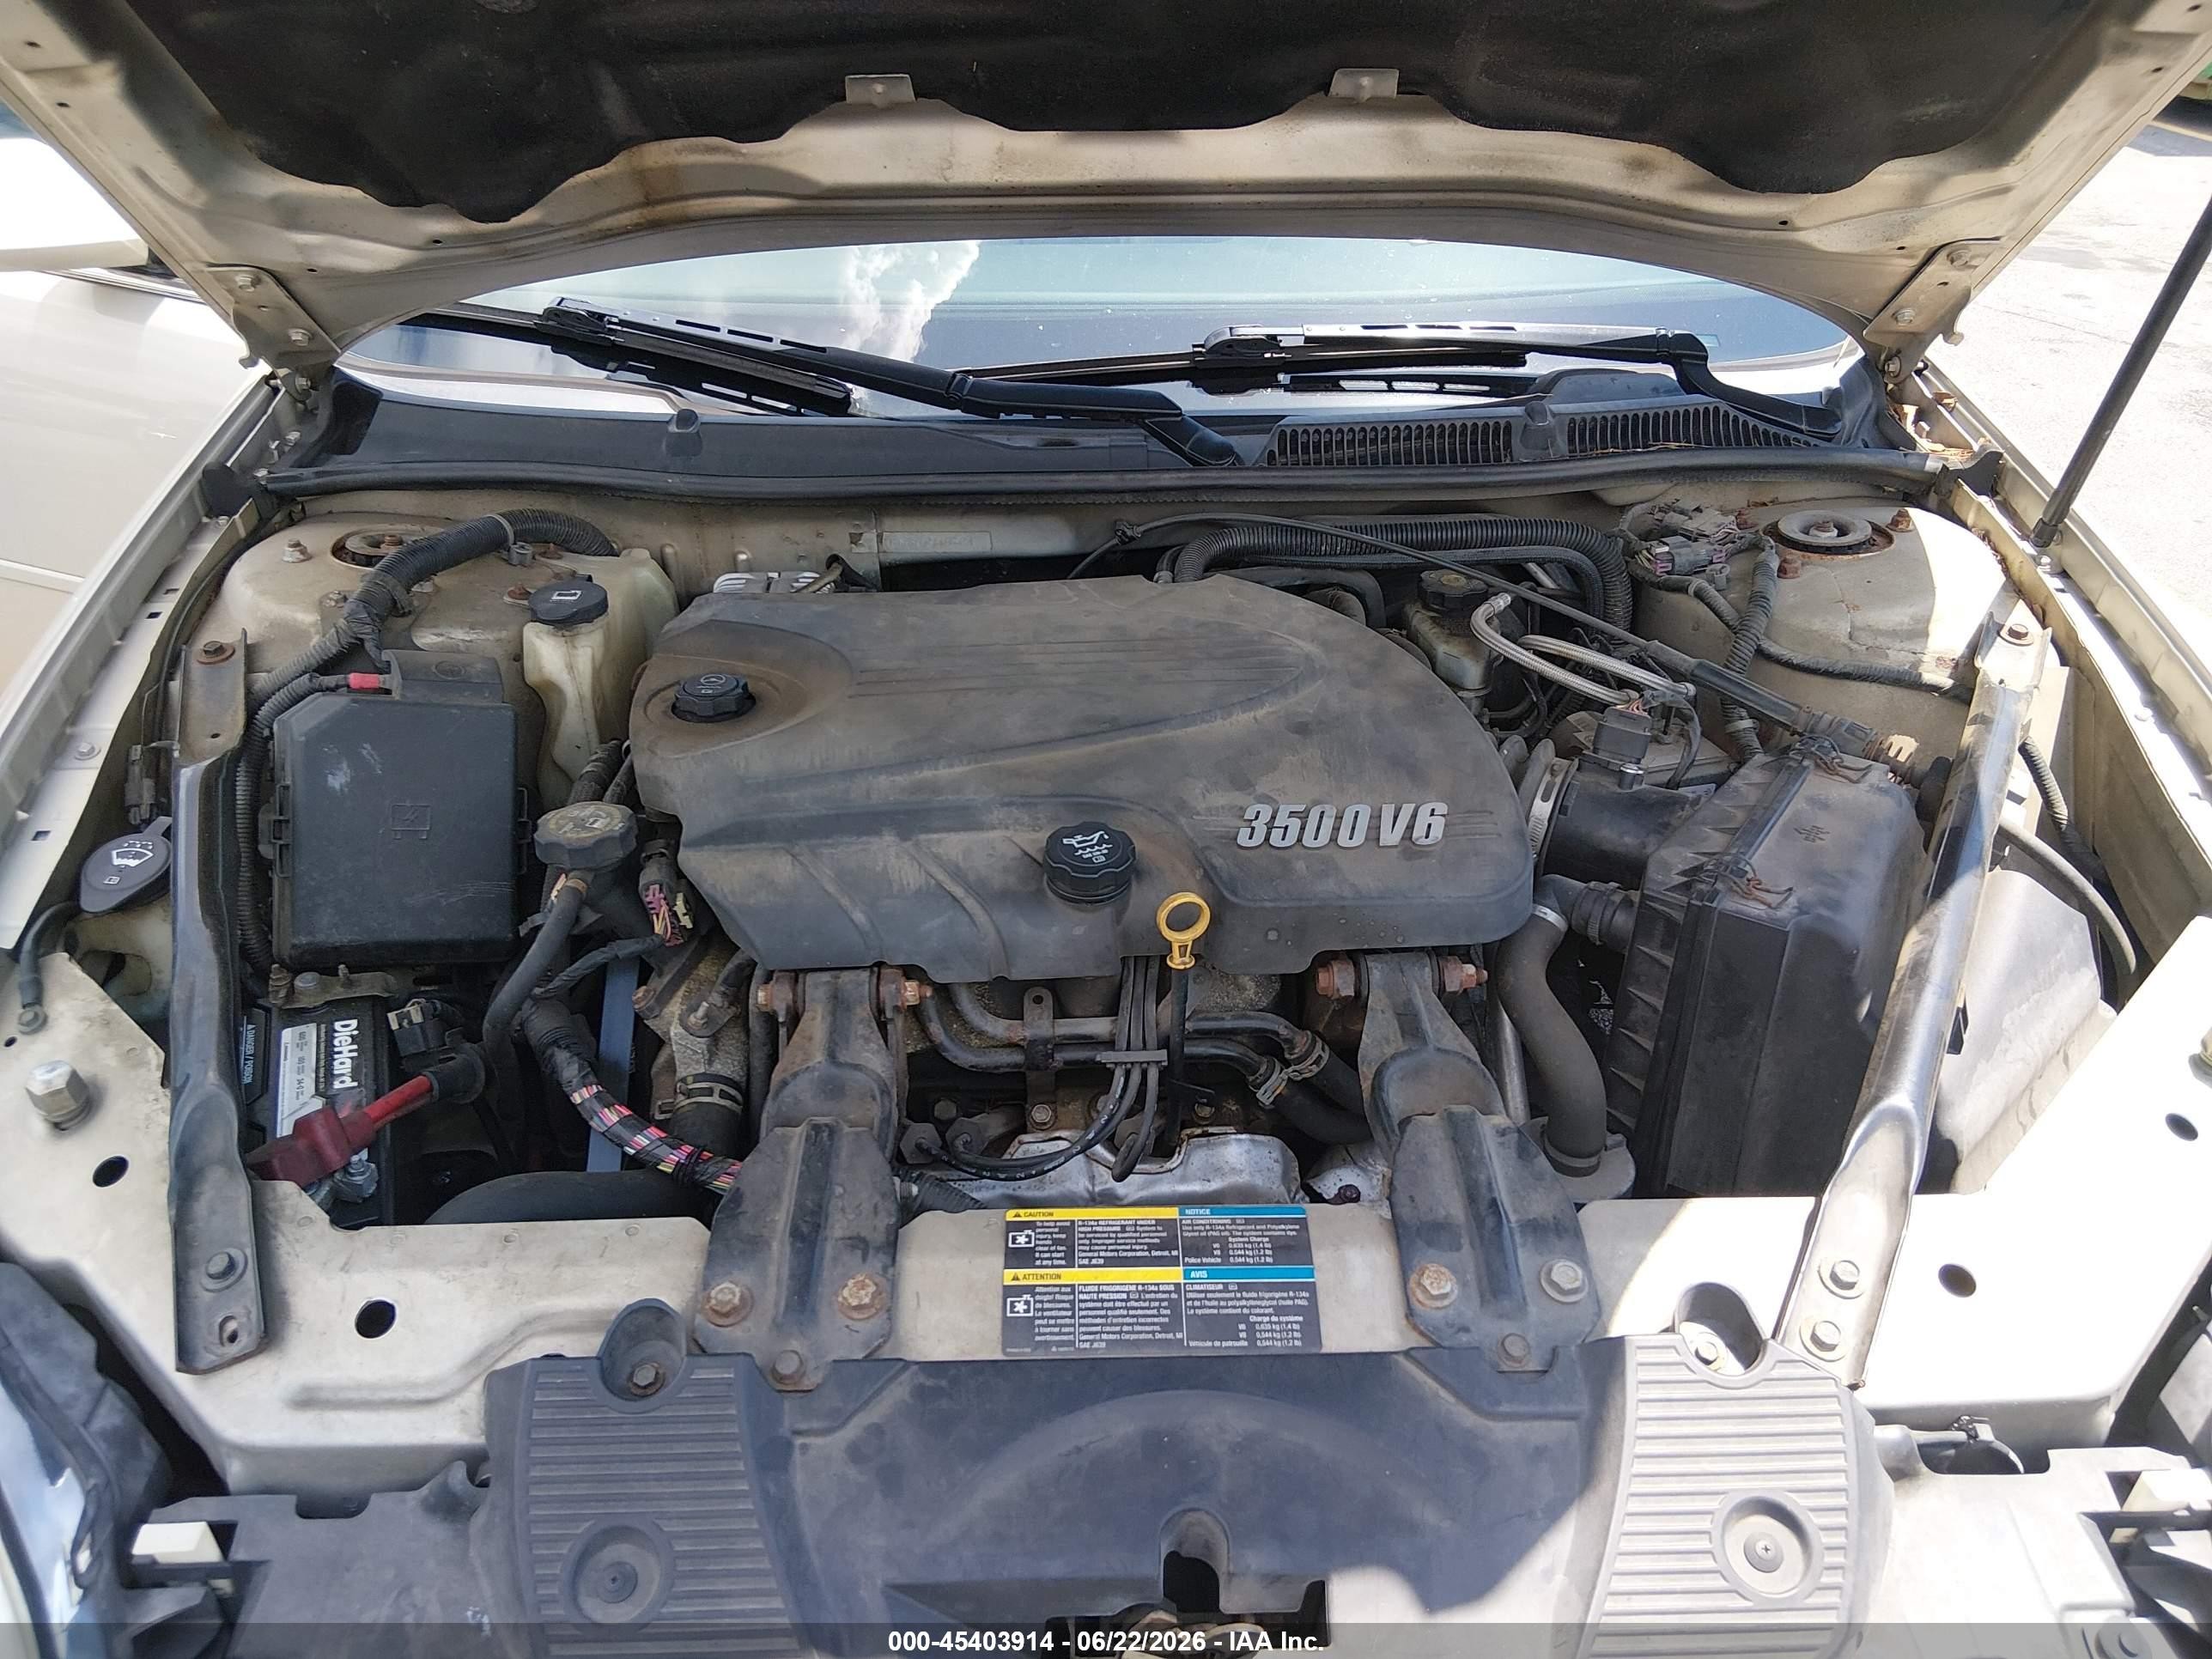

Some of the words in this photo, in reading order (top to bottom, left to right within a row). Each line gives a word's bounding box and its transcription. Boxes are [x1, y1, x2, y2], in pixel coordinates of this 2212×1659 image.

[1237, 803, 1371, 848] 3500
[1379, 802, 1449, 846] V6
[245, 1030, 256, 1056] DANGER
[333, 1019, 359, 1089] DieHard
